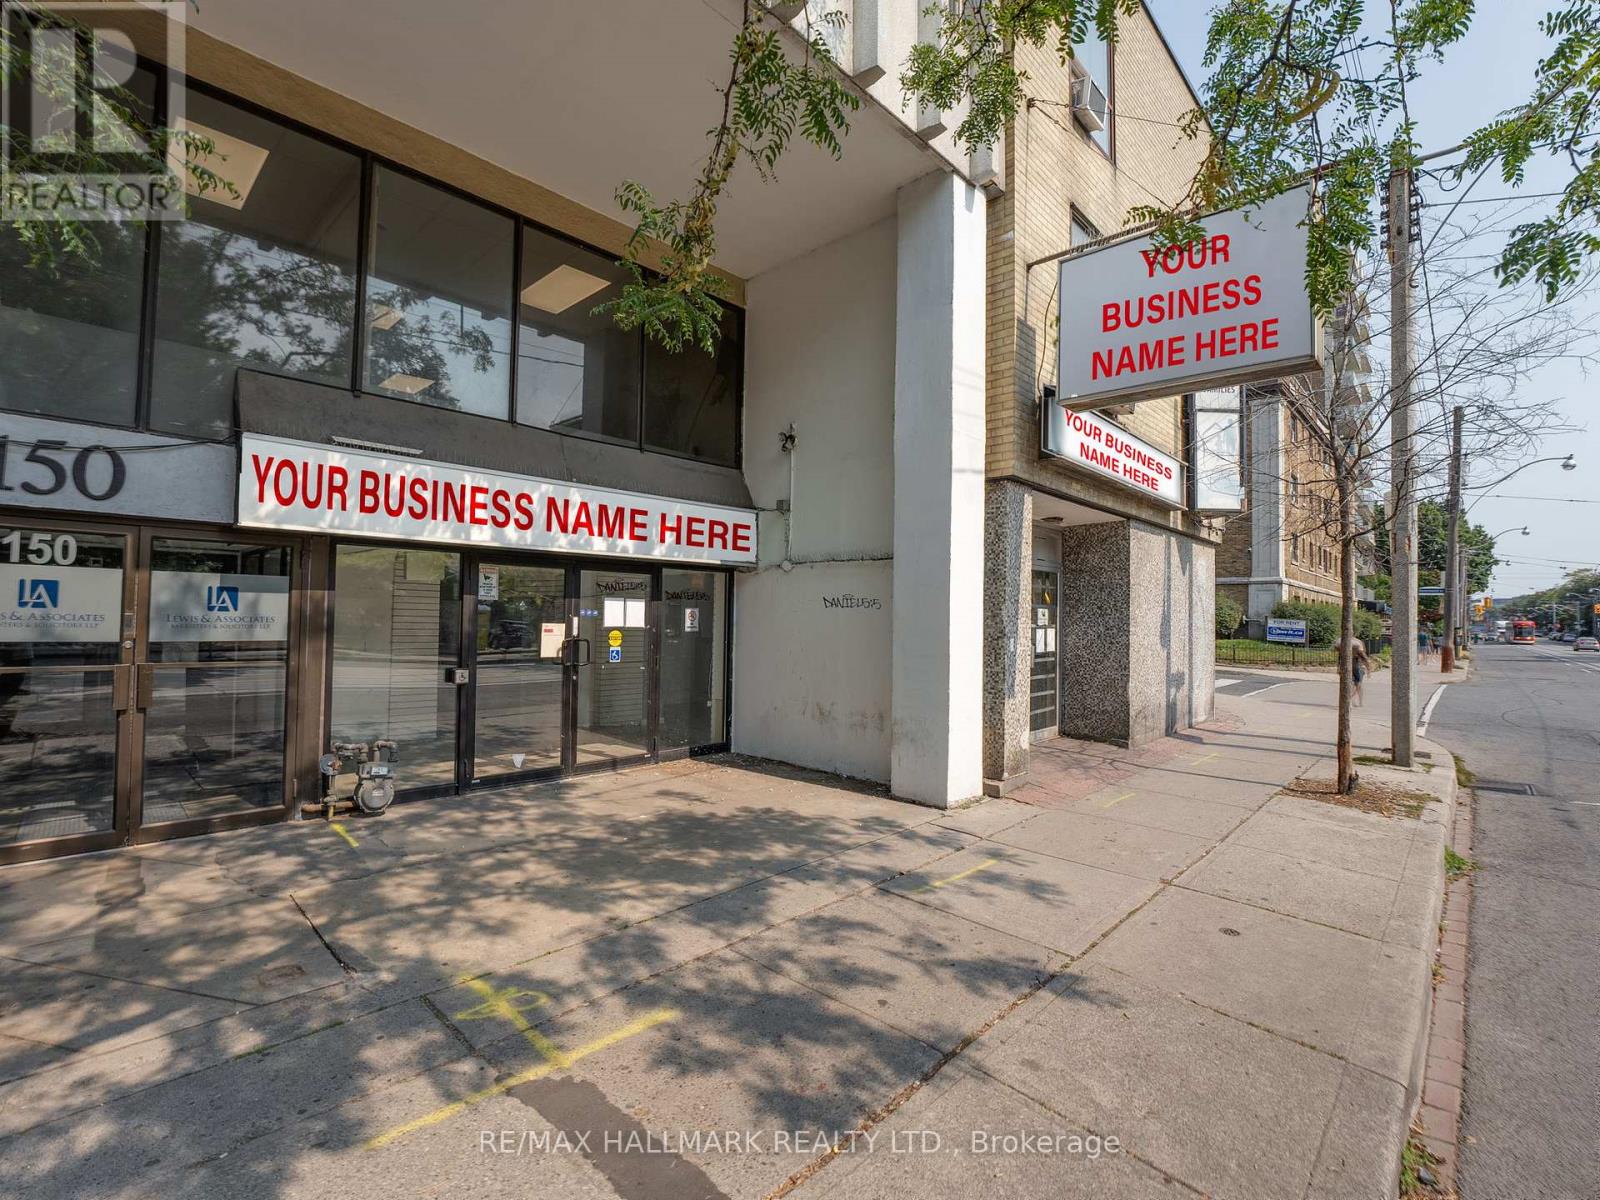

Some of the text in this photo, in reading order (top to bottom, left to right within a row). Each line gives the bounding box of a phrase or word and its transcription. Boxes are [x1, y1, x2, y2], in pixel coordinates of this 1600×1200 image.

[1140, 233, 1231, 278] YOUR
[1101, 274, 1262, 333] BUSINESS
[1091, 318, 1280, 381] NAME HERE
[0, 435, 127, 501] 150
[1065, 410, 1173, 480] YOUR BUSINESS
[1079, 442, 1159, 491] NAME HERE
[251, 454, 753, 553] YOUR BUSINESS NAME HERE
[1, 530, 77, 566] 150
[167, 613, 199, 623] LEWIS
[214, 614, 276, 623] ASSOCIATES
